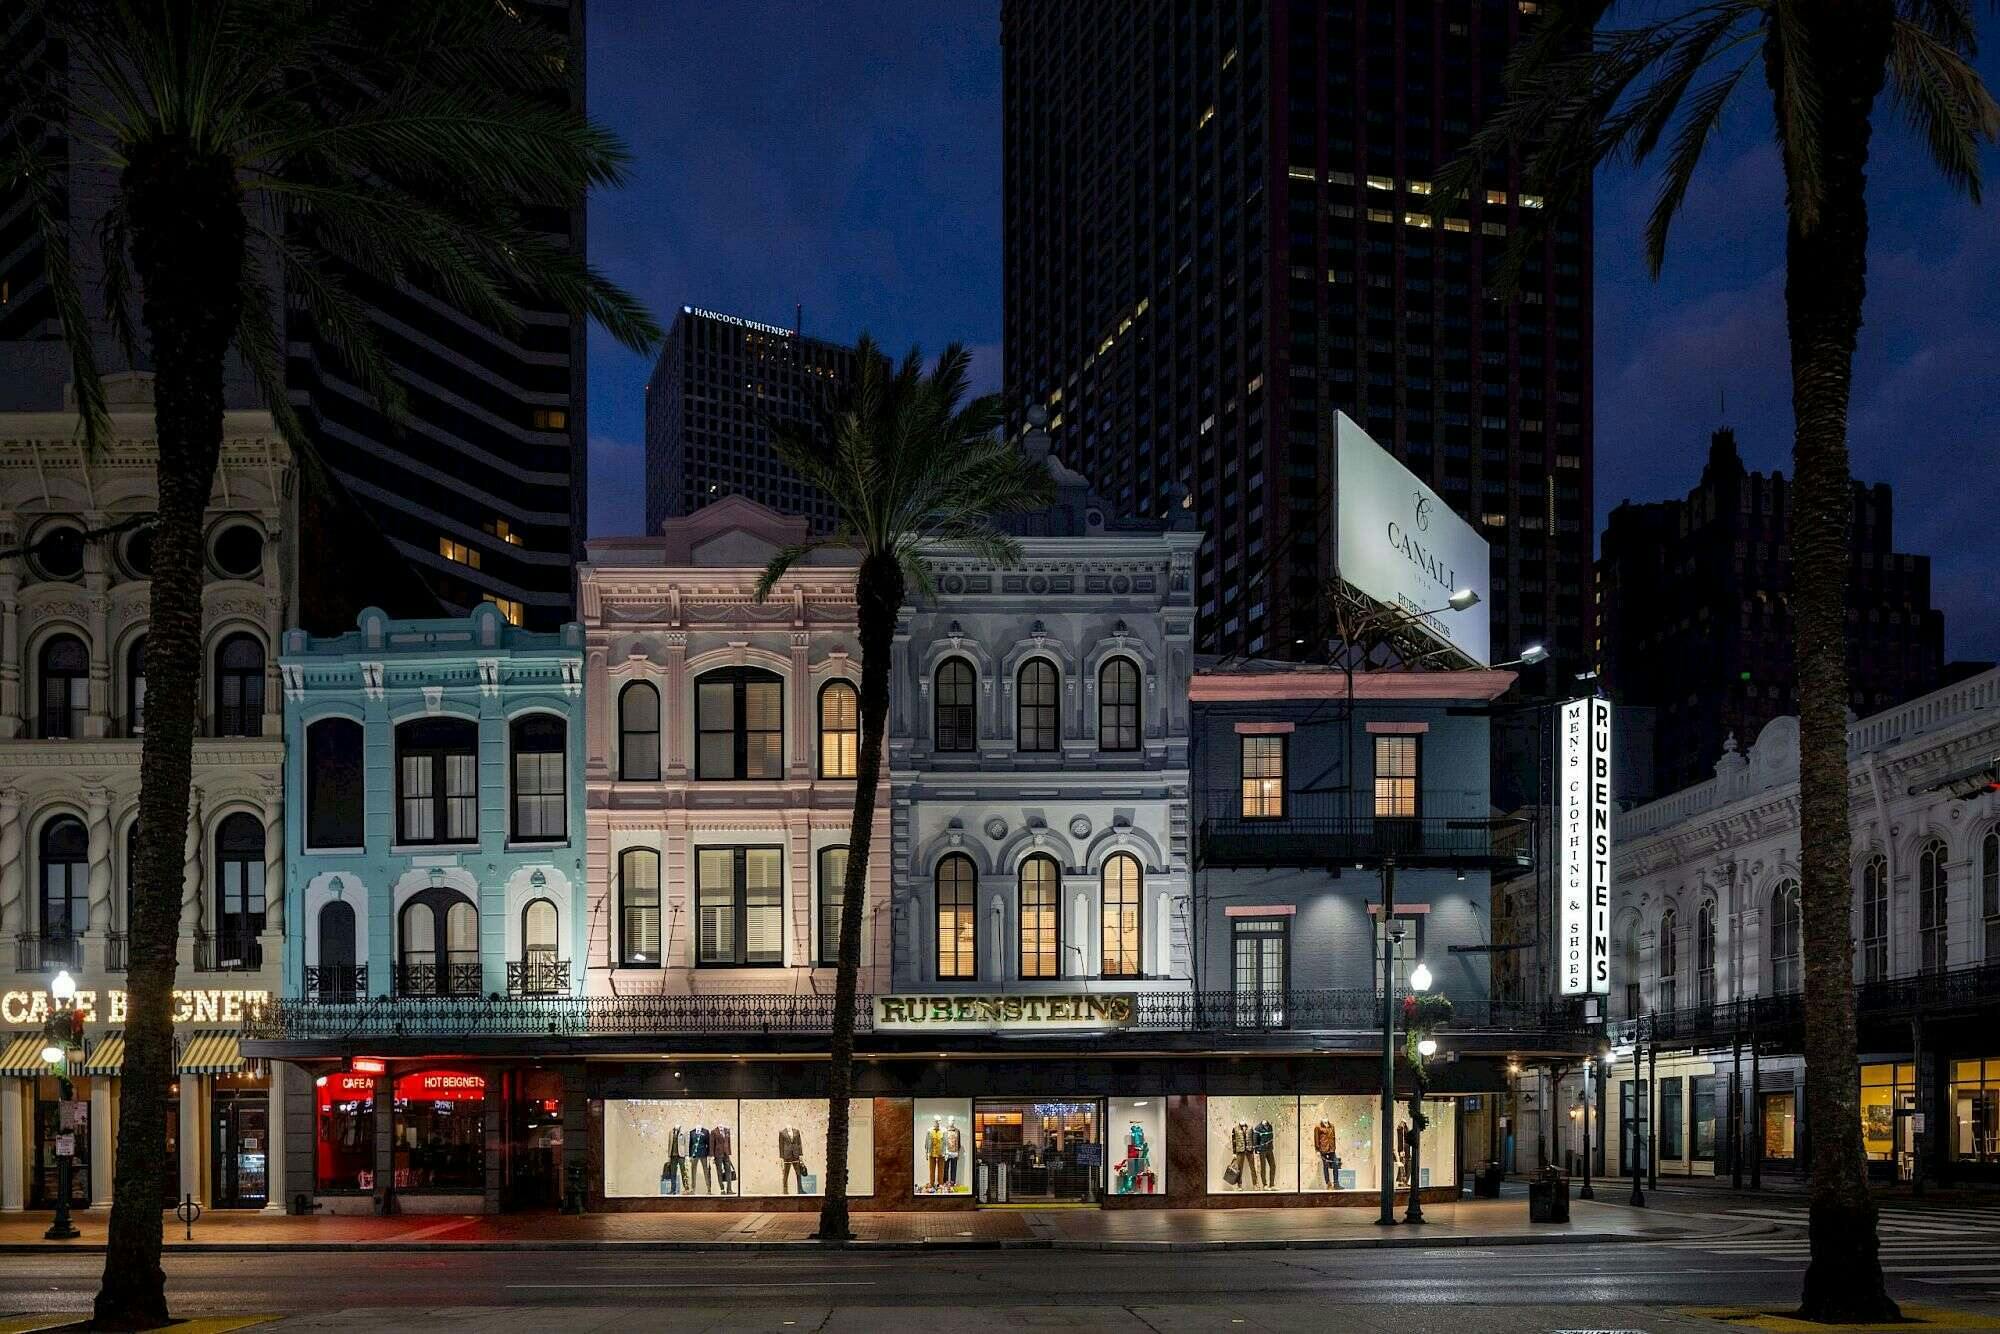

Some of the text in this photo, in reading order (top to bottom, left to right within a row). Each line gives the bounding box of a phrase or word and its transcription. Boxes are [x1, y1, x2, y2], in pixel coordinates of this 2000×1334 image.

[695, 307, 790, 337] HANCOCK WHITNEY
[1388, 522, 1454, 591] CANALI
[1569, 707, 1581, 988] MEN'S CLOTHING & SHOES
[1595, 704, 1608, 981] RUBENSTEINS
[108, 990, 268, 1023] BGNET
[880, 995, 1131, 1022] RUBENSTEINS
[342, 1078, 365, 1089] CAFE
[424, 1077, 442, 1089] HOT
